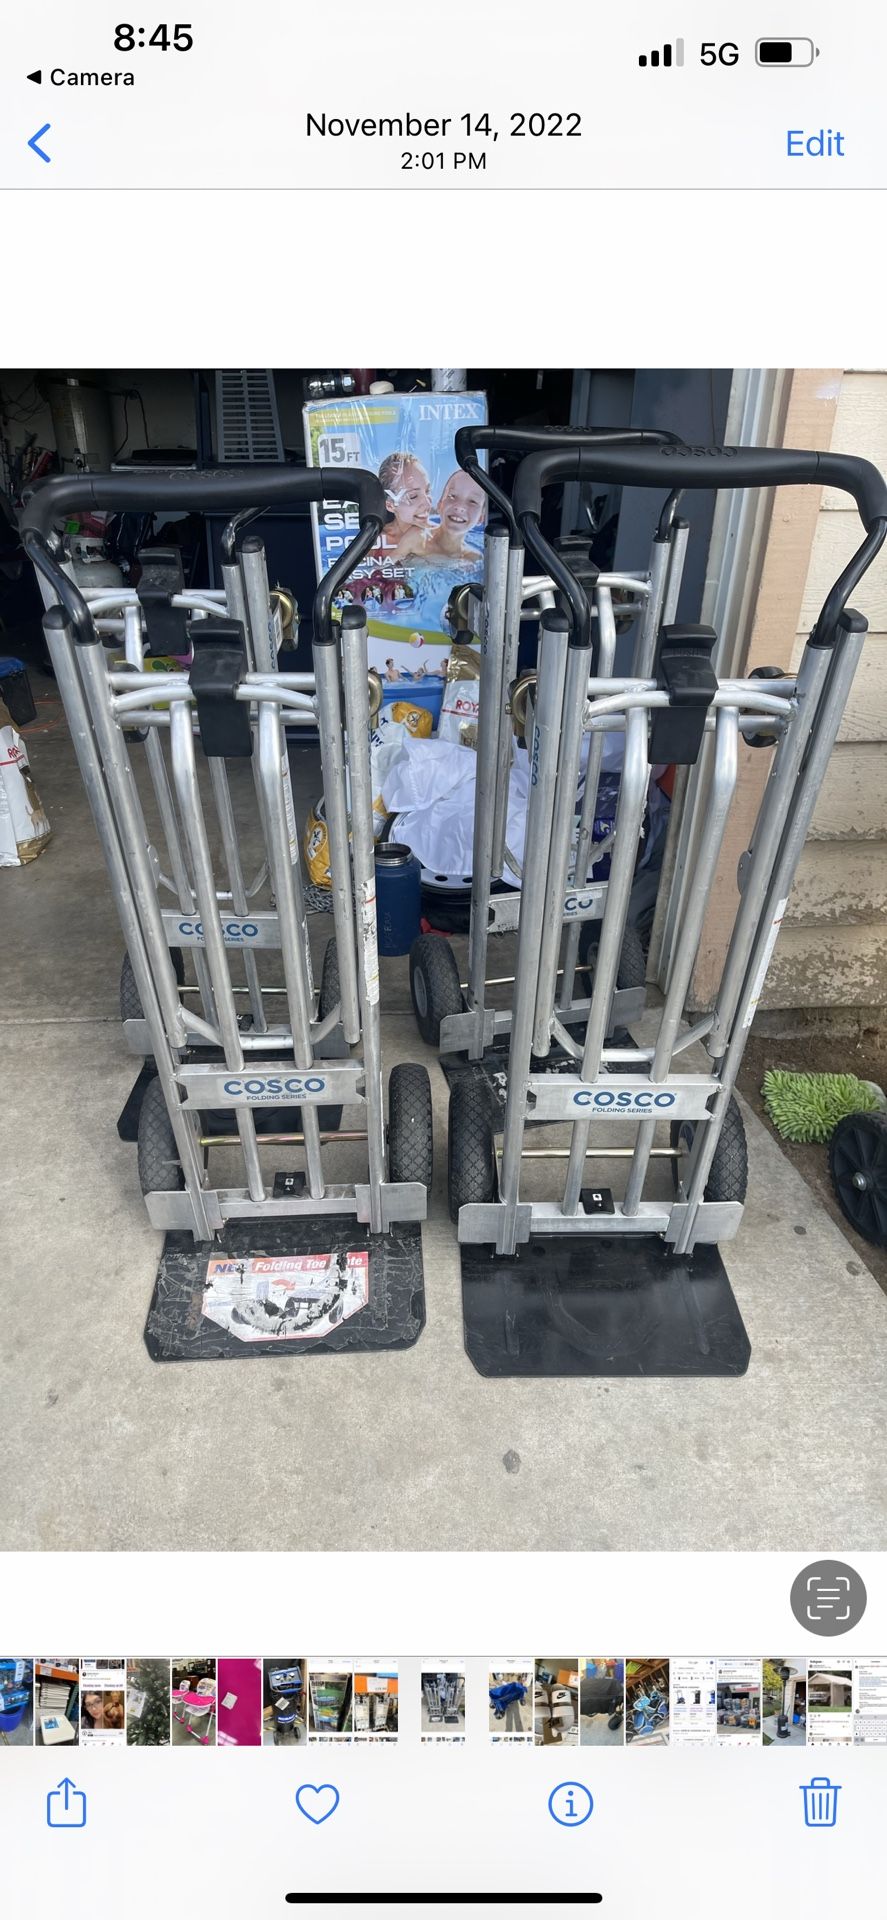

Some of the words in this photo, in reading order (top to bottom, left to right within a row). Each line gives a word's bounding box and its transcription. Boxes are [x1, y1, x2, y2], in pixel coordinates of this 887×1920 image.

[113, 23, 194, 53] 8:45
[700, 42, 739, 66] 5G
[49, 67, 135, 86] Camera
[305, 112, 452, 139] November
[459, 113, 501, 143] 14,
[508, 113, 583, 139] 2022
[786, 129, 845, 158] Edit
[400, 152, 444, 170] 2:01
[453, 152, 487, 170] PM
[419, 403, 479, 421] INTEX
[320, 438, 346, 463] 15
[382, 567, 415, 579] SET
[223, 1078, 325, 1096] COSCO
[246, 1093, 280, 1101] FOLDING
[573, 1090, 675, 1107] COSCO
[255, 1260, 302, 1271] Folding
[306, 1259, 327, 1269] Toe
